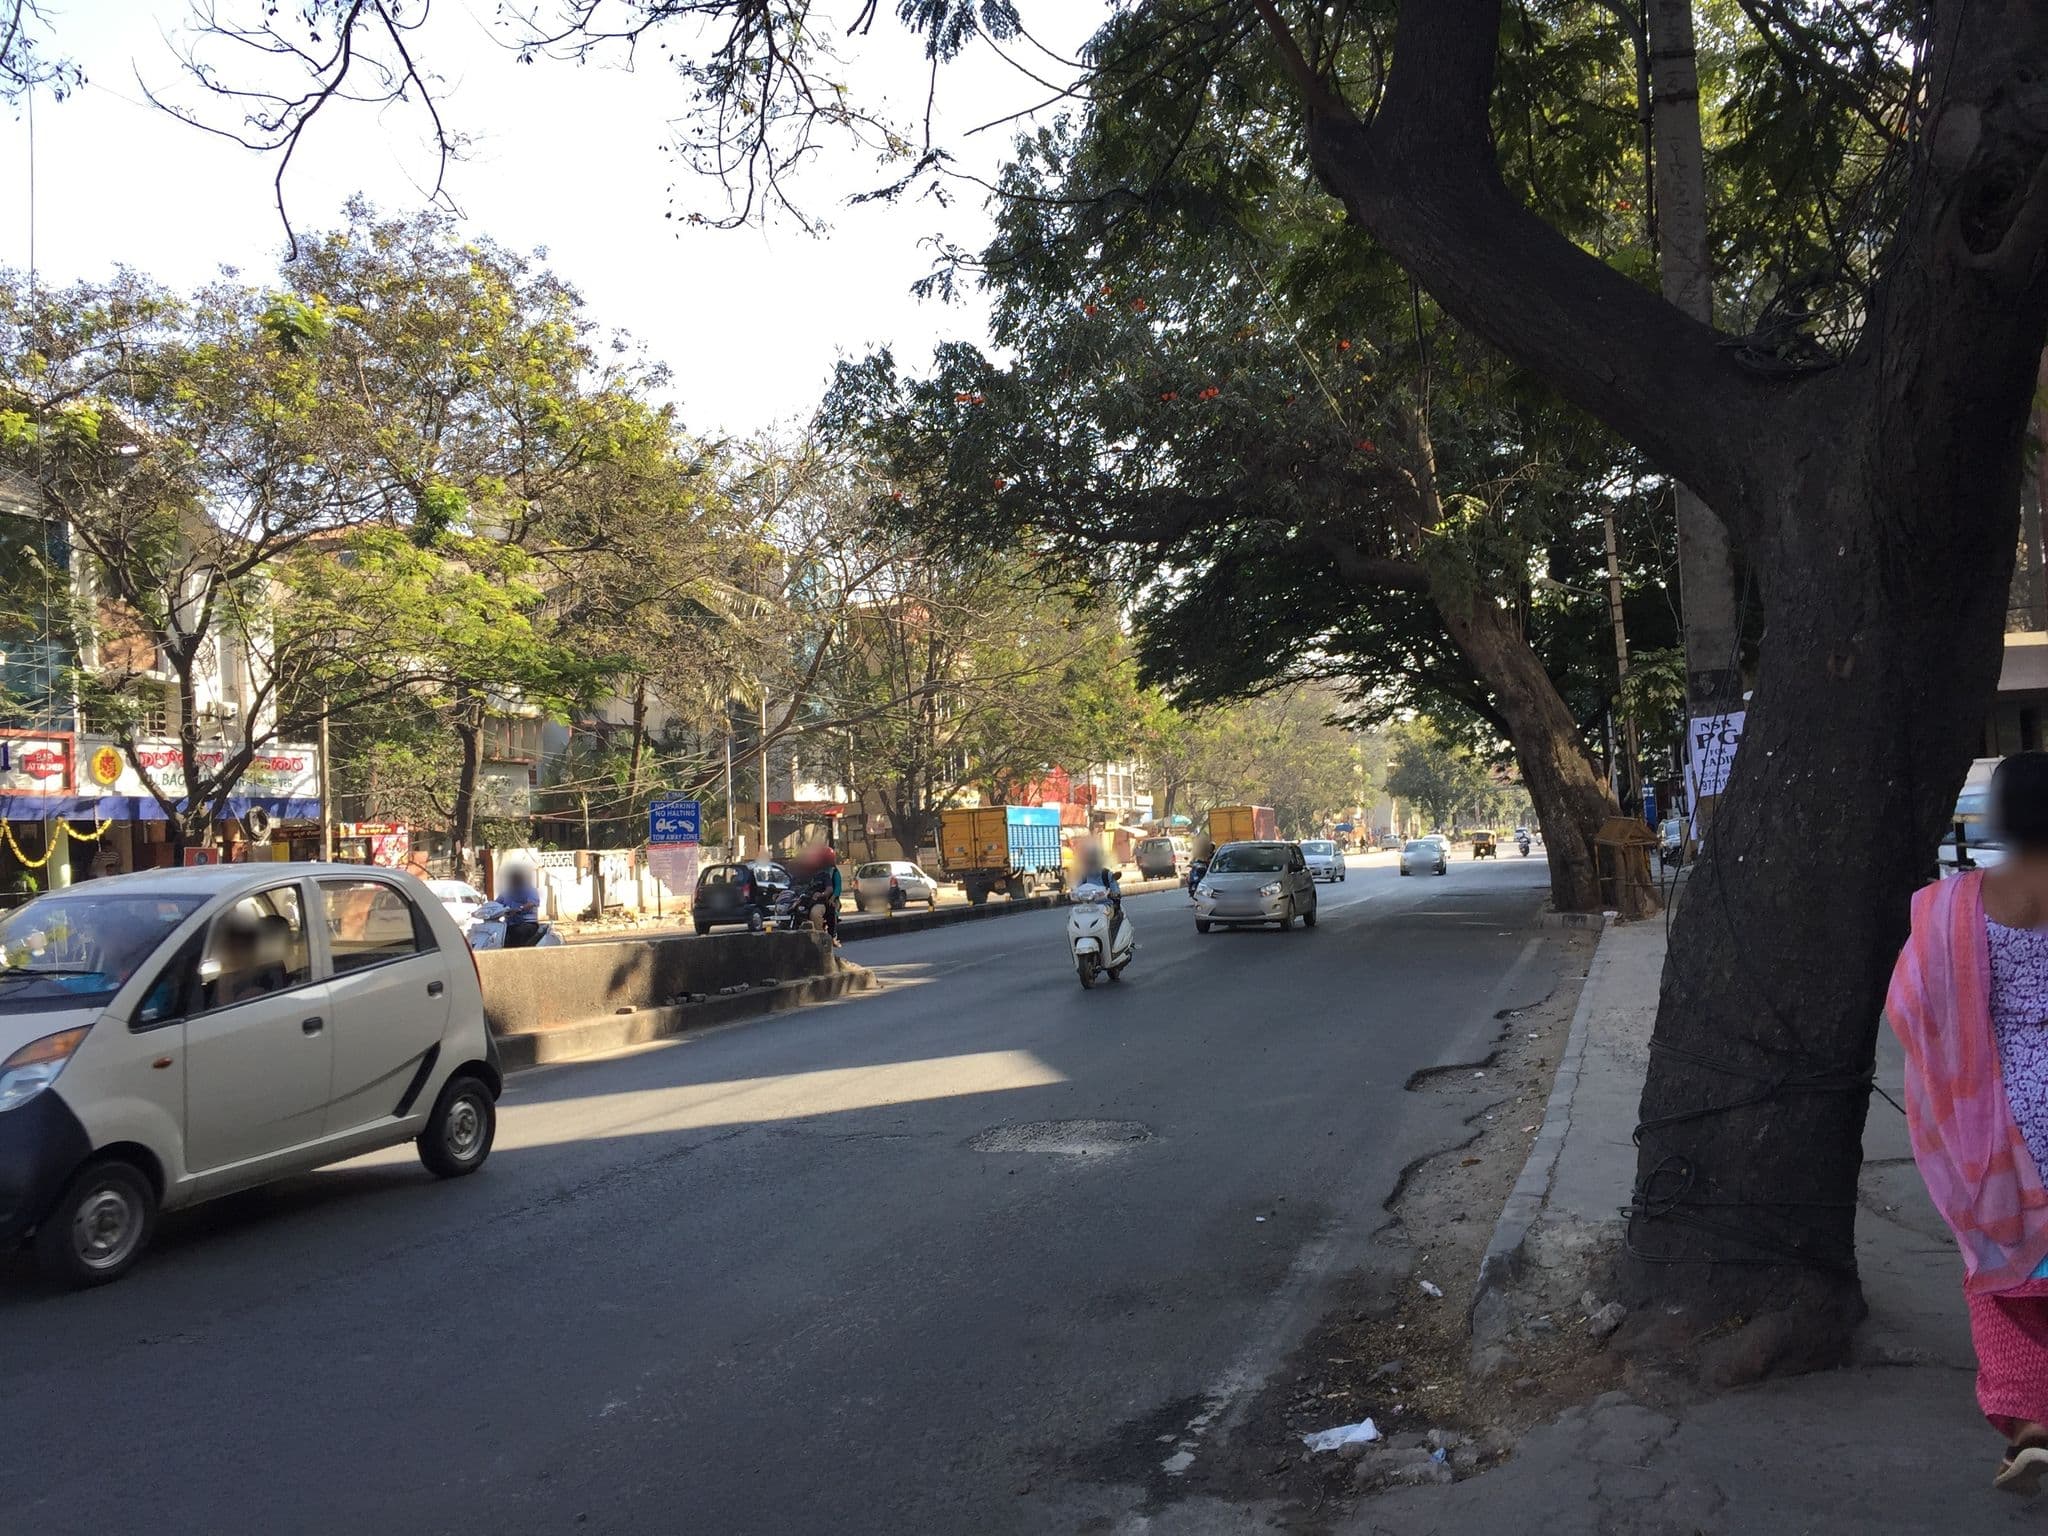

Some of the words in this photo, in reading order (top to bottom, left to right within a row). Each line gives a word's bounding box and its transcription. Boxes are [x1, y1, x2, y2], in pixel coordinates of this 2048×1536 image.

[1696, 729, 1738, 750] PG
[36, 753, 55, 764] BAR
[667, 802, 696, 810] PARKING
